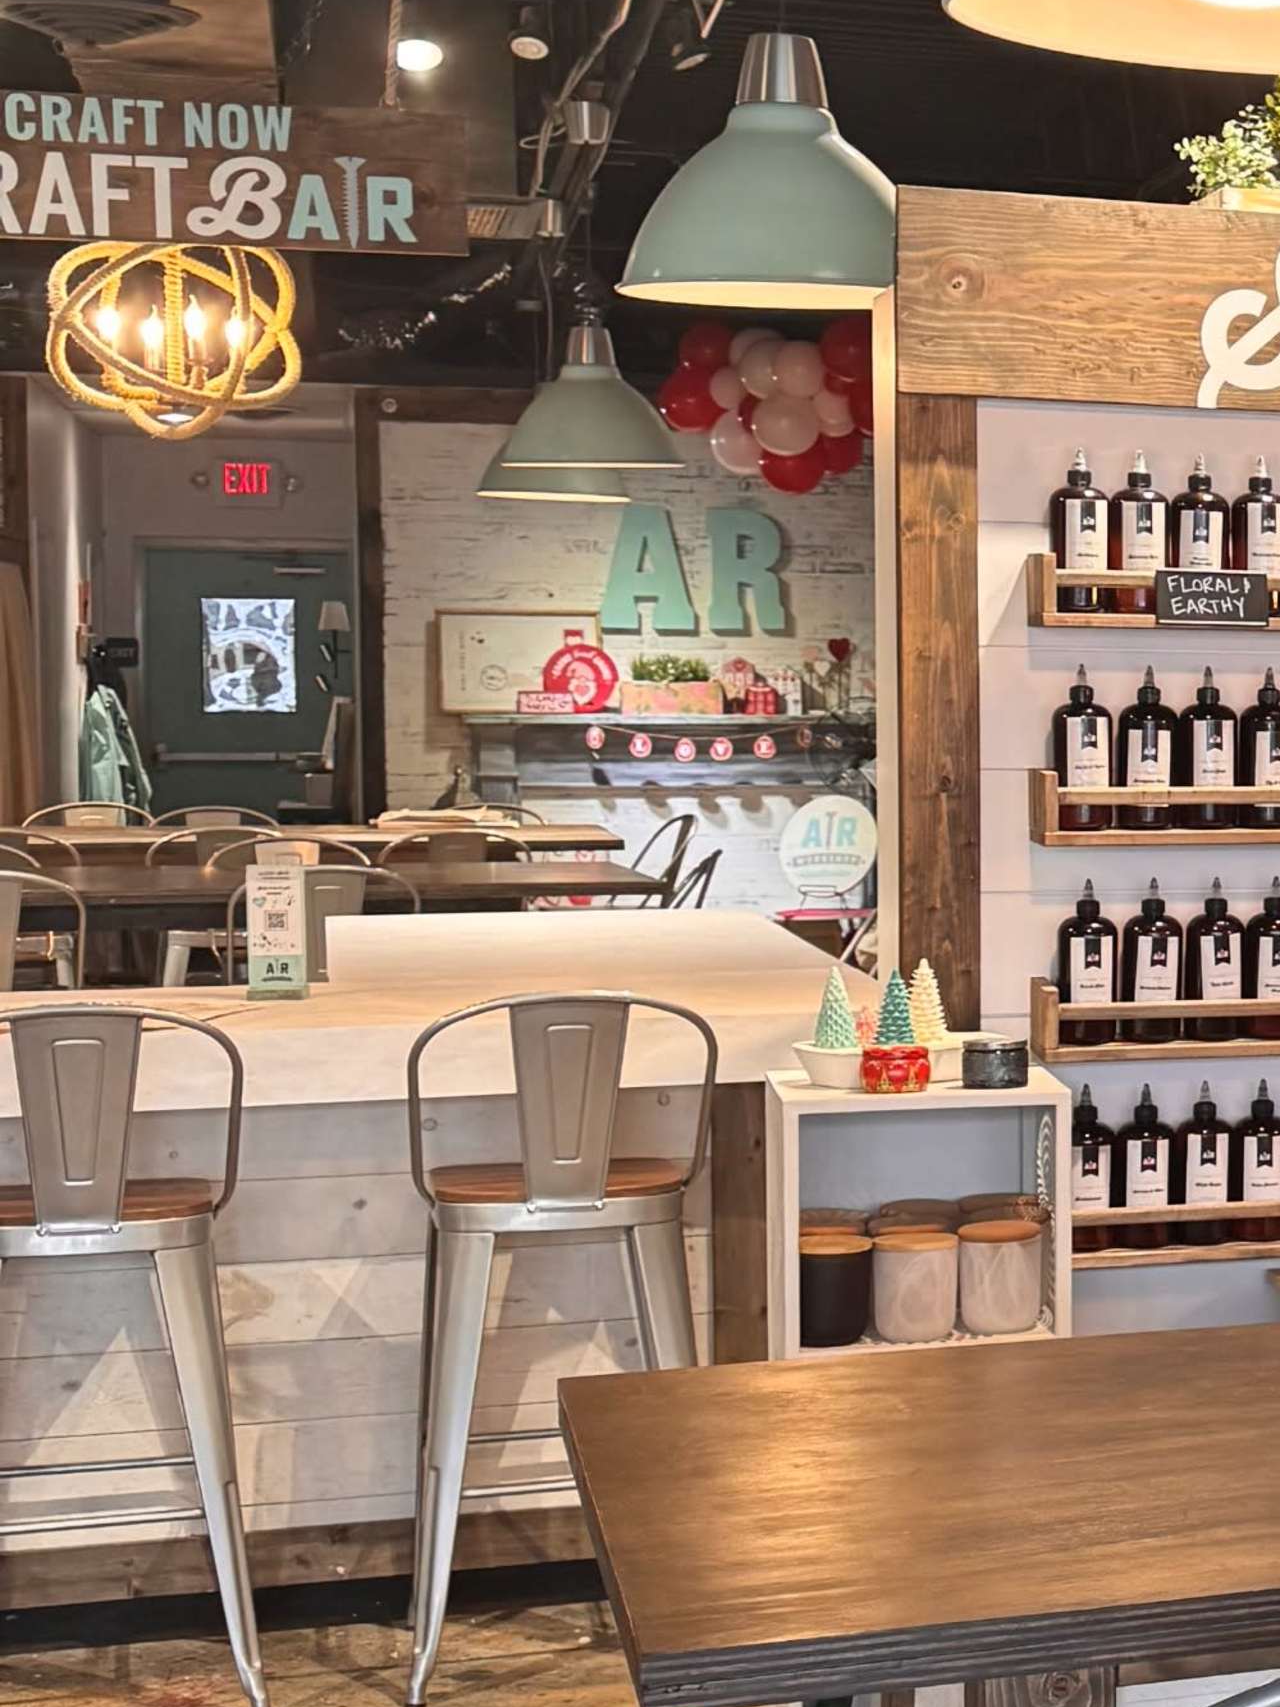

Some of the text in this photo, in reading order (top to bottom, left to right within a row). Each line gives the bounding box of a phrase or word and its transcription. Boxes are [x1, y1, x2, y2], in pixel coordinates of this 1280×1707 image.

[4, 93, 292, 151] CRAFT NOW
[223, 462, 272, 495] EXIT
[600, 505, 788, 634] AR
[1167, 575, 1240, 594] FLORAL
[1170, 596, 1245, 618] EARTHY
